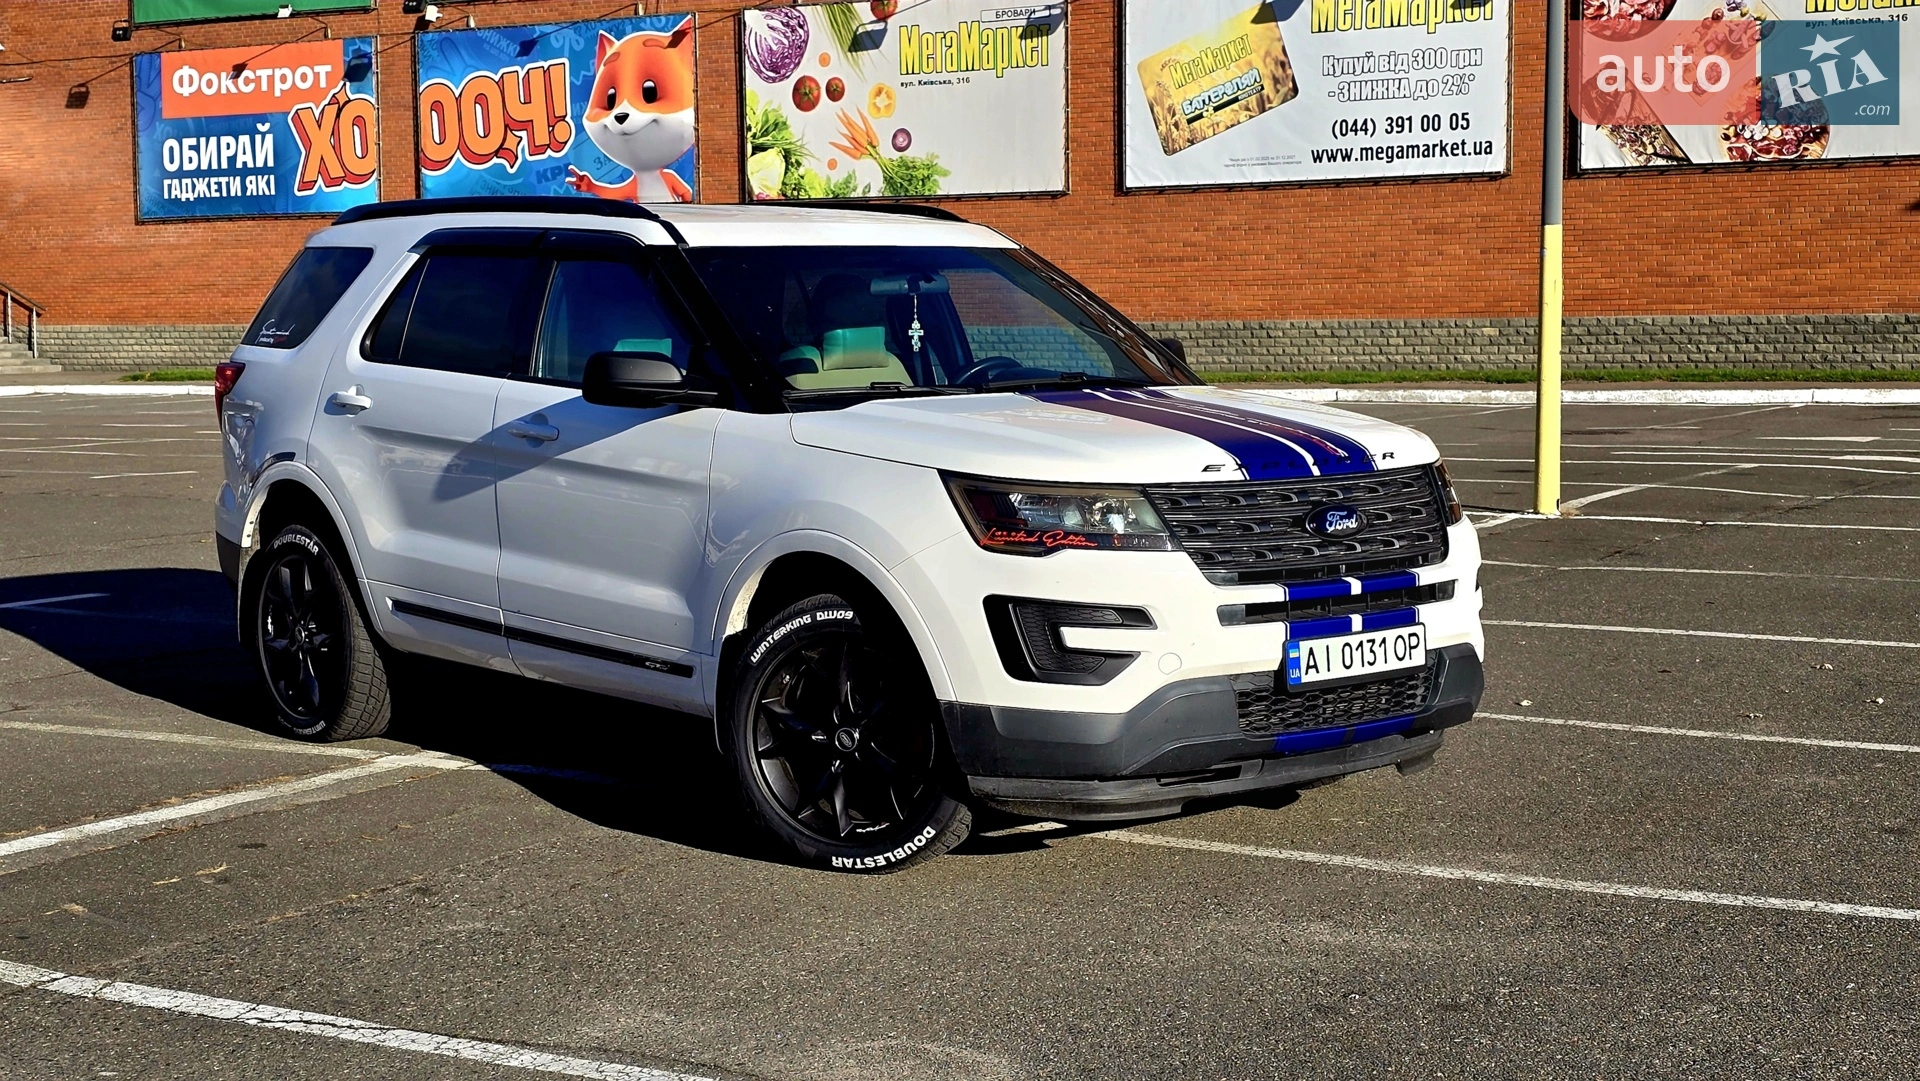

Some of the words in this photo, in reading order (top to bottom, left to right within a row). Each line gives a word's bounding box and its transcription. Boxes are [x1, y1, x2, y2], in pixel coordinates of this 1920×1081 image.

[995, 8, 1036, 19] БРОВАРИ
[1805, 21, 1828, 29] вул.
[1831, 16, 1884, 26] Київська,
[1888, 14, 1908, 22] 316
[899, 20, 1050, 78] МегаМаркет
[1168, 34, 1252, 90] МегаМаркет
[1322, 51, 1376, 77] Купуй
[1378, 51, 1410, 74] від
[1411, 47, 1449, 70] 300
[1450, 48, 1483, 70] грн
[172, 64, 332, 97] Фокстрот
[900, 79, 916, 88] вул.
[918, 79, 954, 87] Київська,
[1337, 78, 1411, 102] ЗНИЖКА
[1412, 79, 1440, 100] до
[1331, 117, 1377, 140] (044)
[1384, 115, 1413, 135] 391
[1420, 113, 1442, 132] 00
[1449, 112, 1471, 131] 05
[162, 122, 275, 173] ОБИРАЙ
[1311, 139, 1493, 164] www.megamarket.ua
[163, 176, 242, 201] ГАДЖЕТИ
[246, 175, 276, 196] ЯКІ
[1326, 511, 1358, 533] Ford
[273, 534, 319, 556] DOUBLESTAR
[980, 527, 1041, 546] Limited
[1042, 530, 1098, 547] Edition
[750, 614, 812, 664] WINTERKING
[1304, 644, 1331, 676] AI
[1341, 636, 1388, 670] 0131
[1393, 632, 1420, 662] OP
[1290, 668, 1300, 678] UA
[832, 825, 936, 869] DOUBLESTAR
